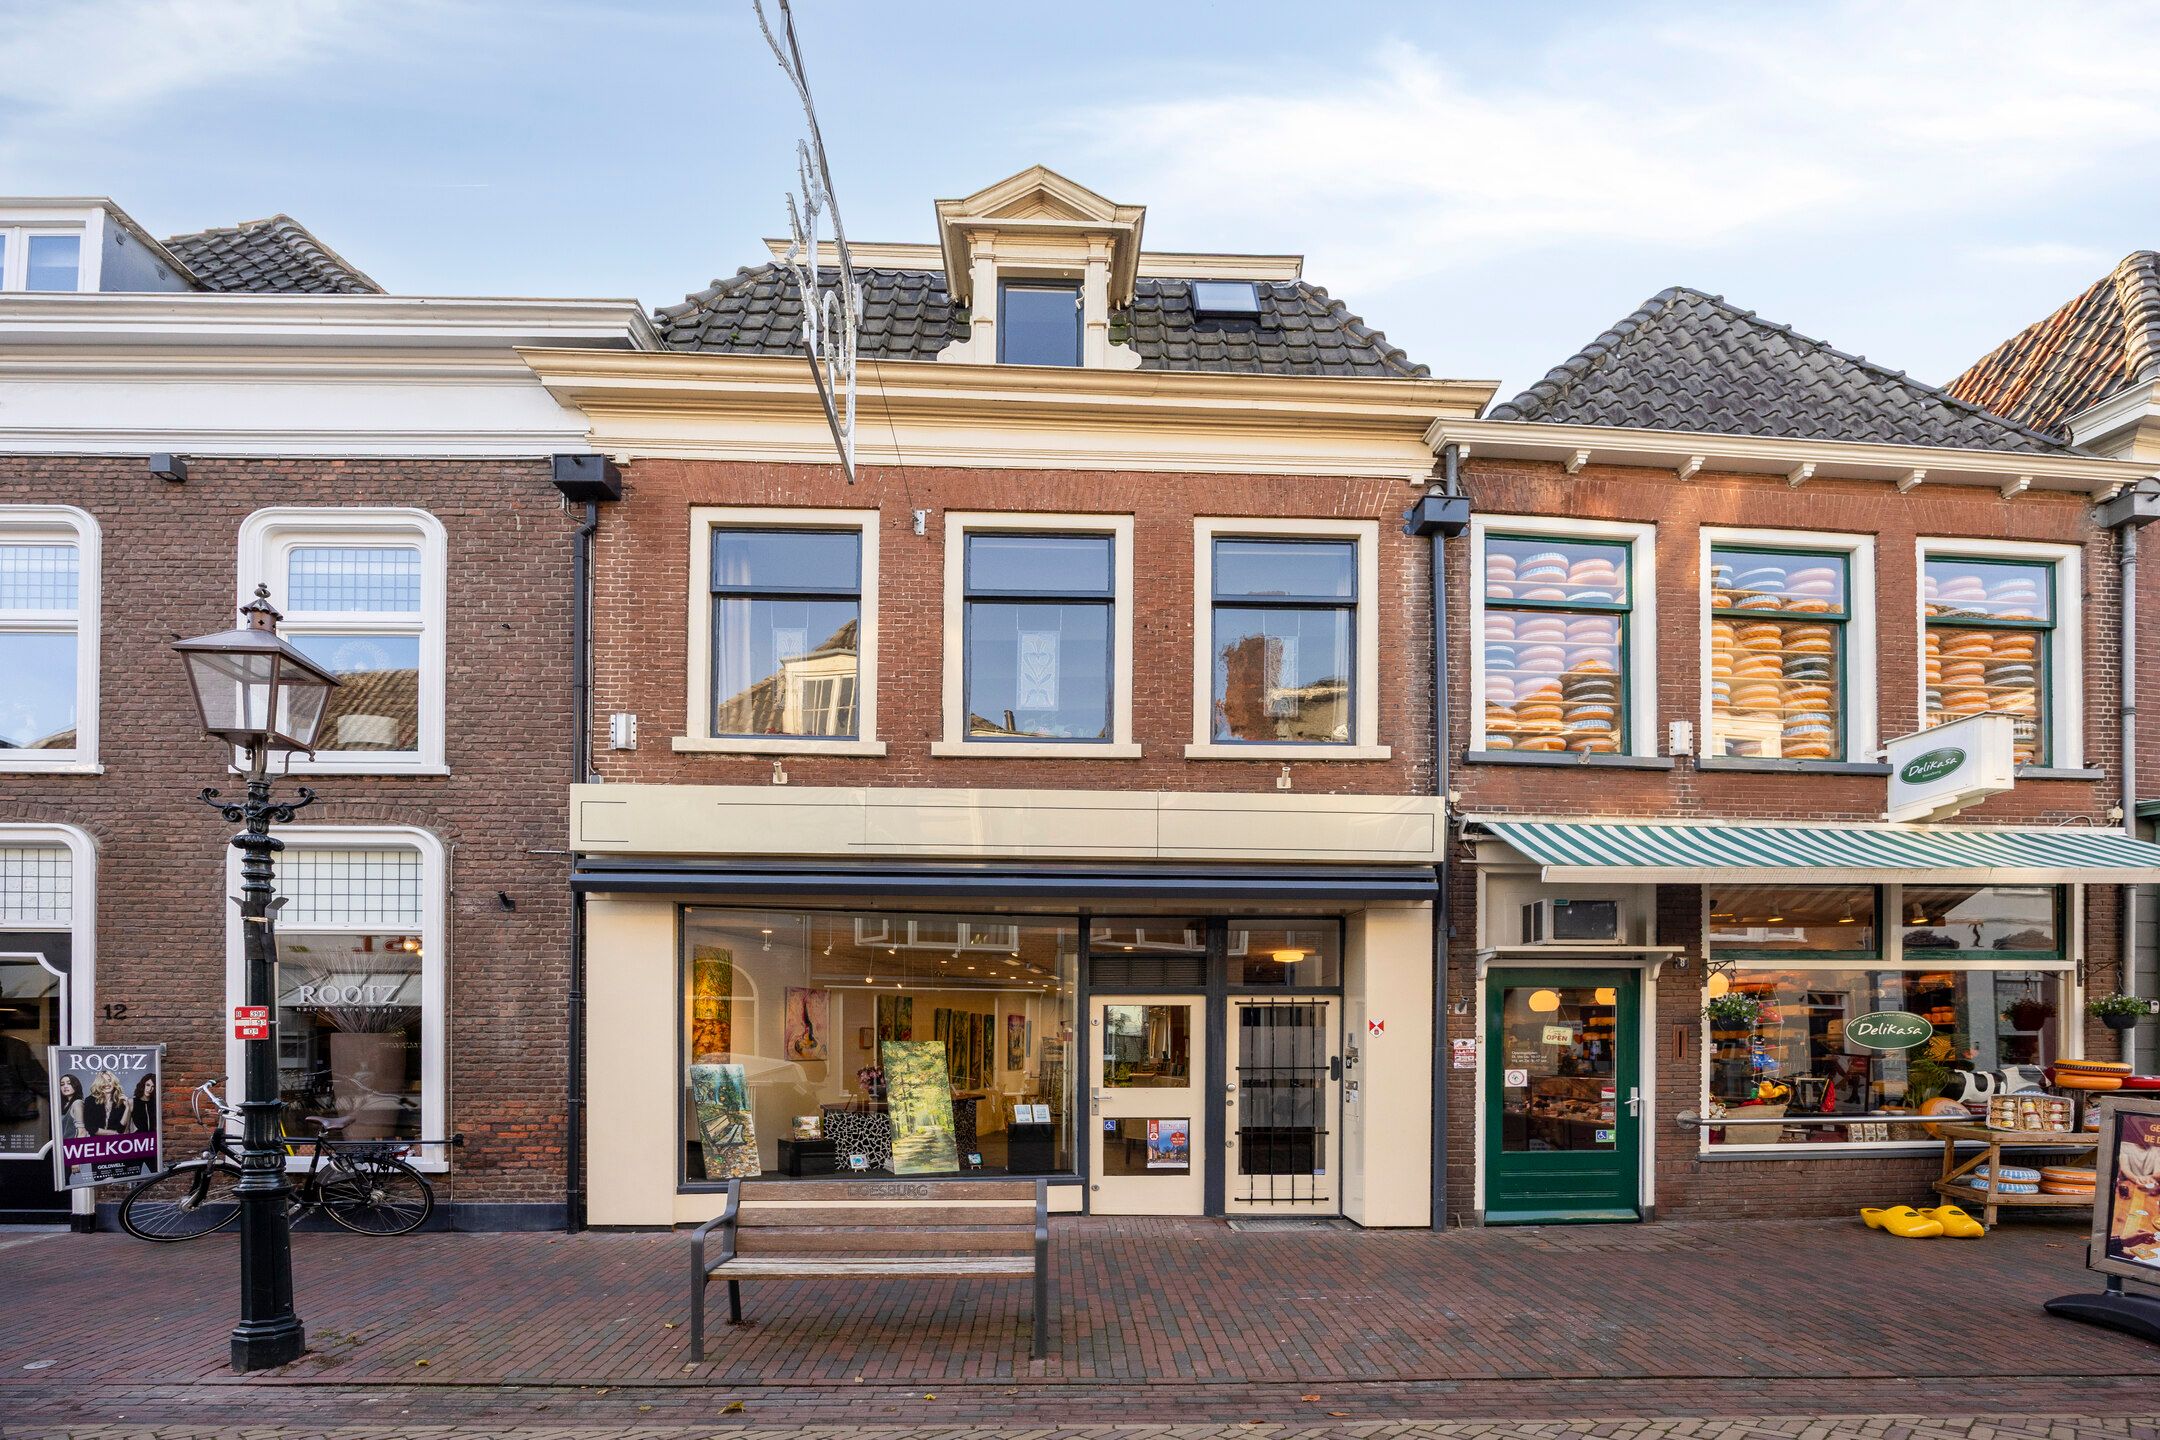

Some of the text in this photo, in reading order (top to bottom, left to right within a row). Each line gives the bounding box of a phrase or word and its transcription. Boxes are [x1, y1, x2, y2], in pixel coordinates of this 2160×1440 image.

[299, 985, 400, 1005] ROOTZ
[104, 1003, 128, 1020] 12
[1546, 1034, 1568, 1042] OPEN
[70, 1053, 147, 1071] ROOTZ
[63, 1138, 154, 1160] WELKOM!
[847, 1184, 928, 1197] DOESBURG
